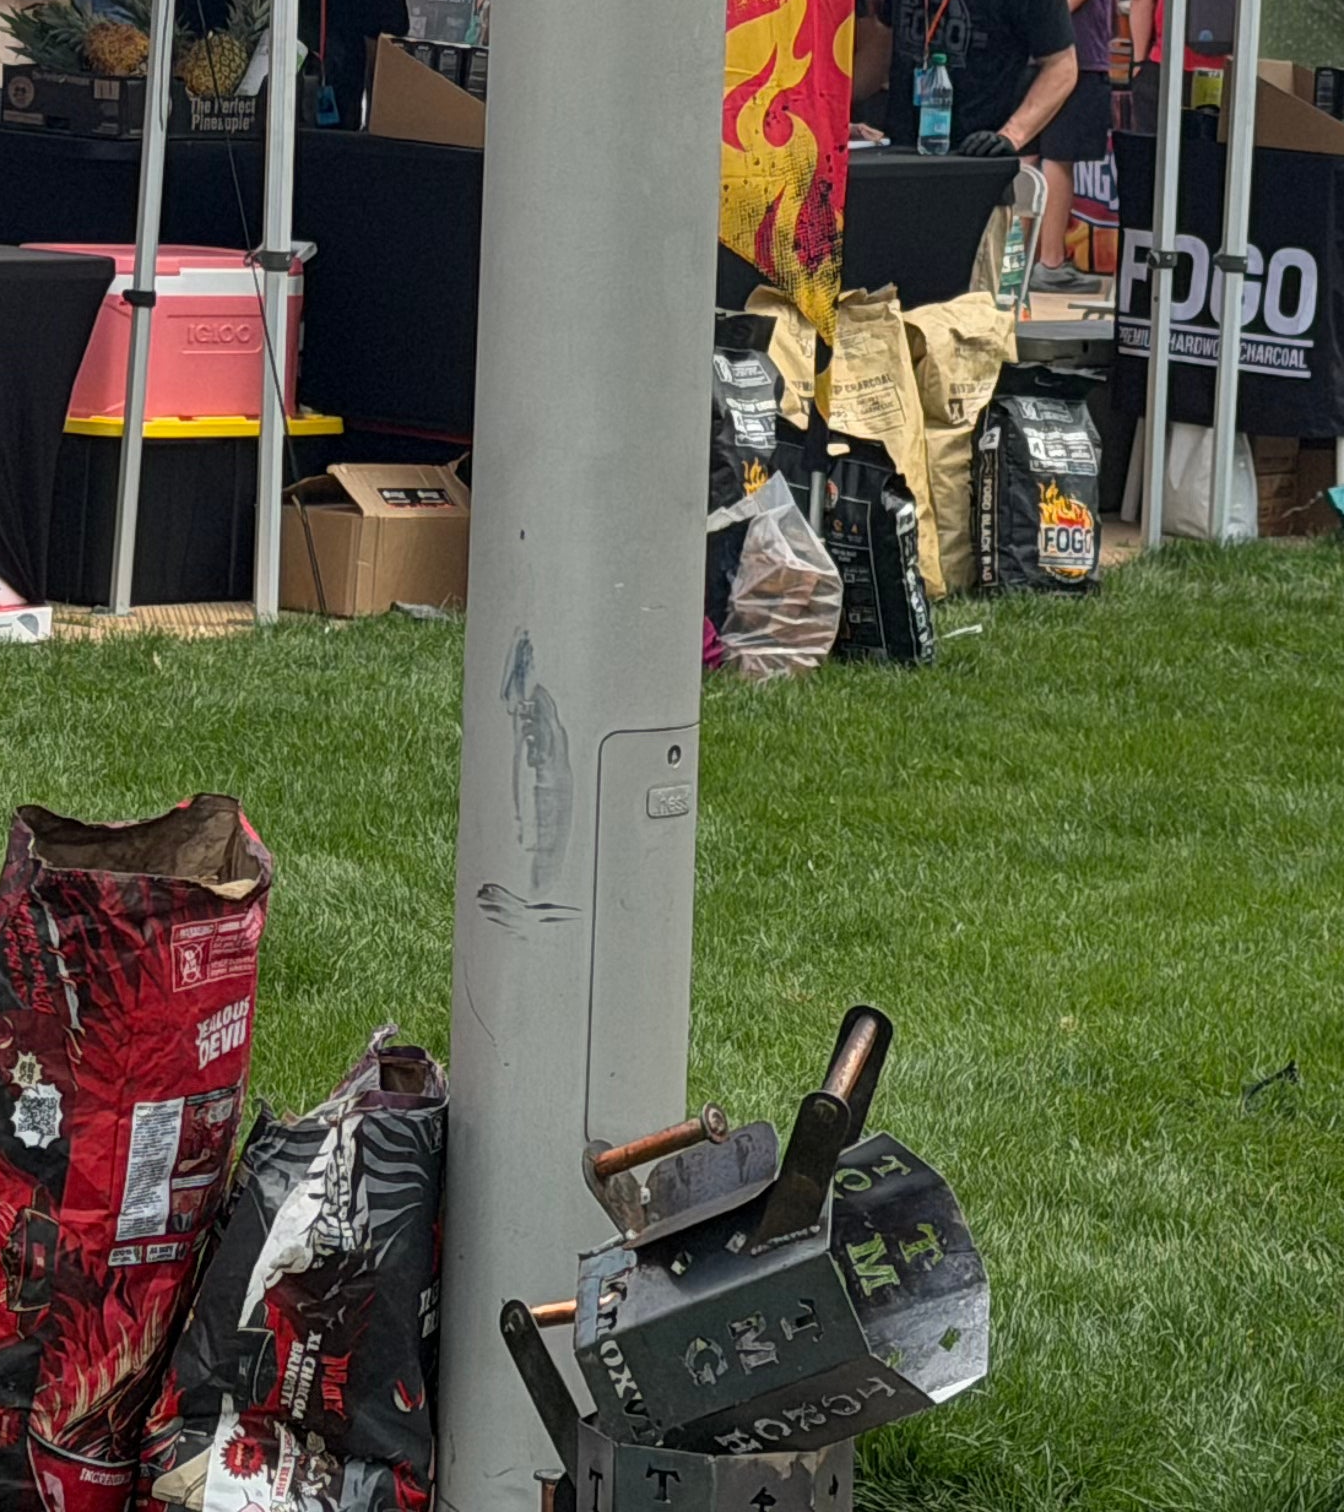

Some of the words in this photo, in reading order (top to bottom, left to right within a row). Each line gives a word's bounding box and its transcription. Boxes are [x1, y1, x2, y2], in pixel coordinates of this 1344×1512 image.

[1119, 228, 1318, 336] FOGO
[1119, 326, 1152, 349] PREMIU
[1168, 328, 1221, 358] HARDWO
[1239, 342, 1308, 369] CHARCOAL
[196, 995, 251, 1036] JEALOUS
